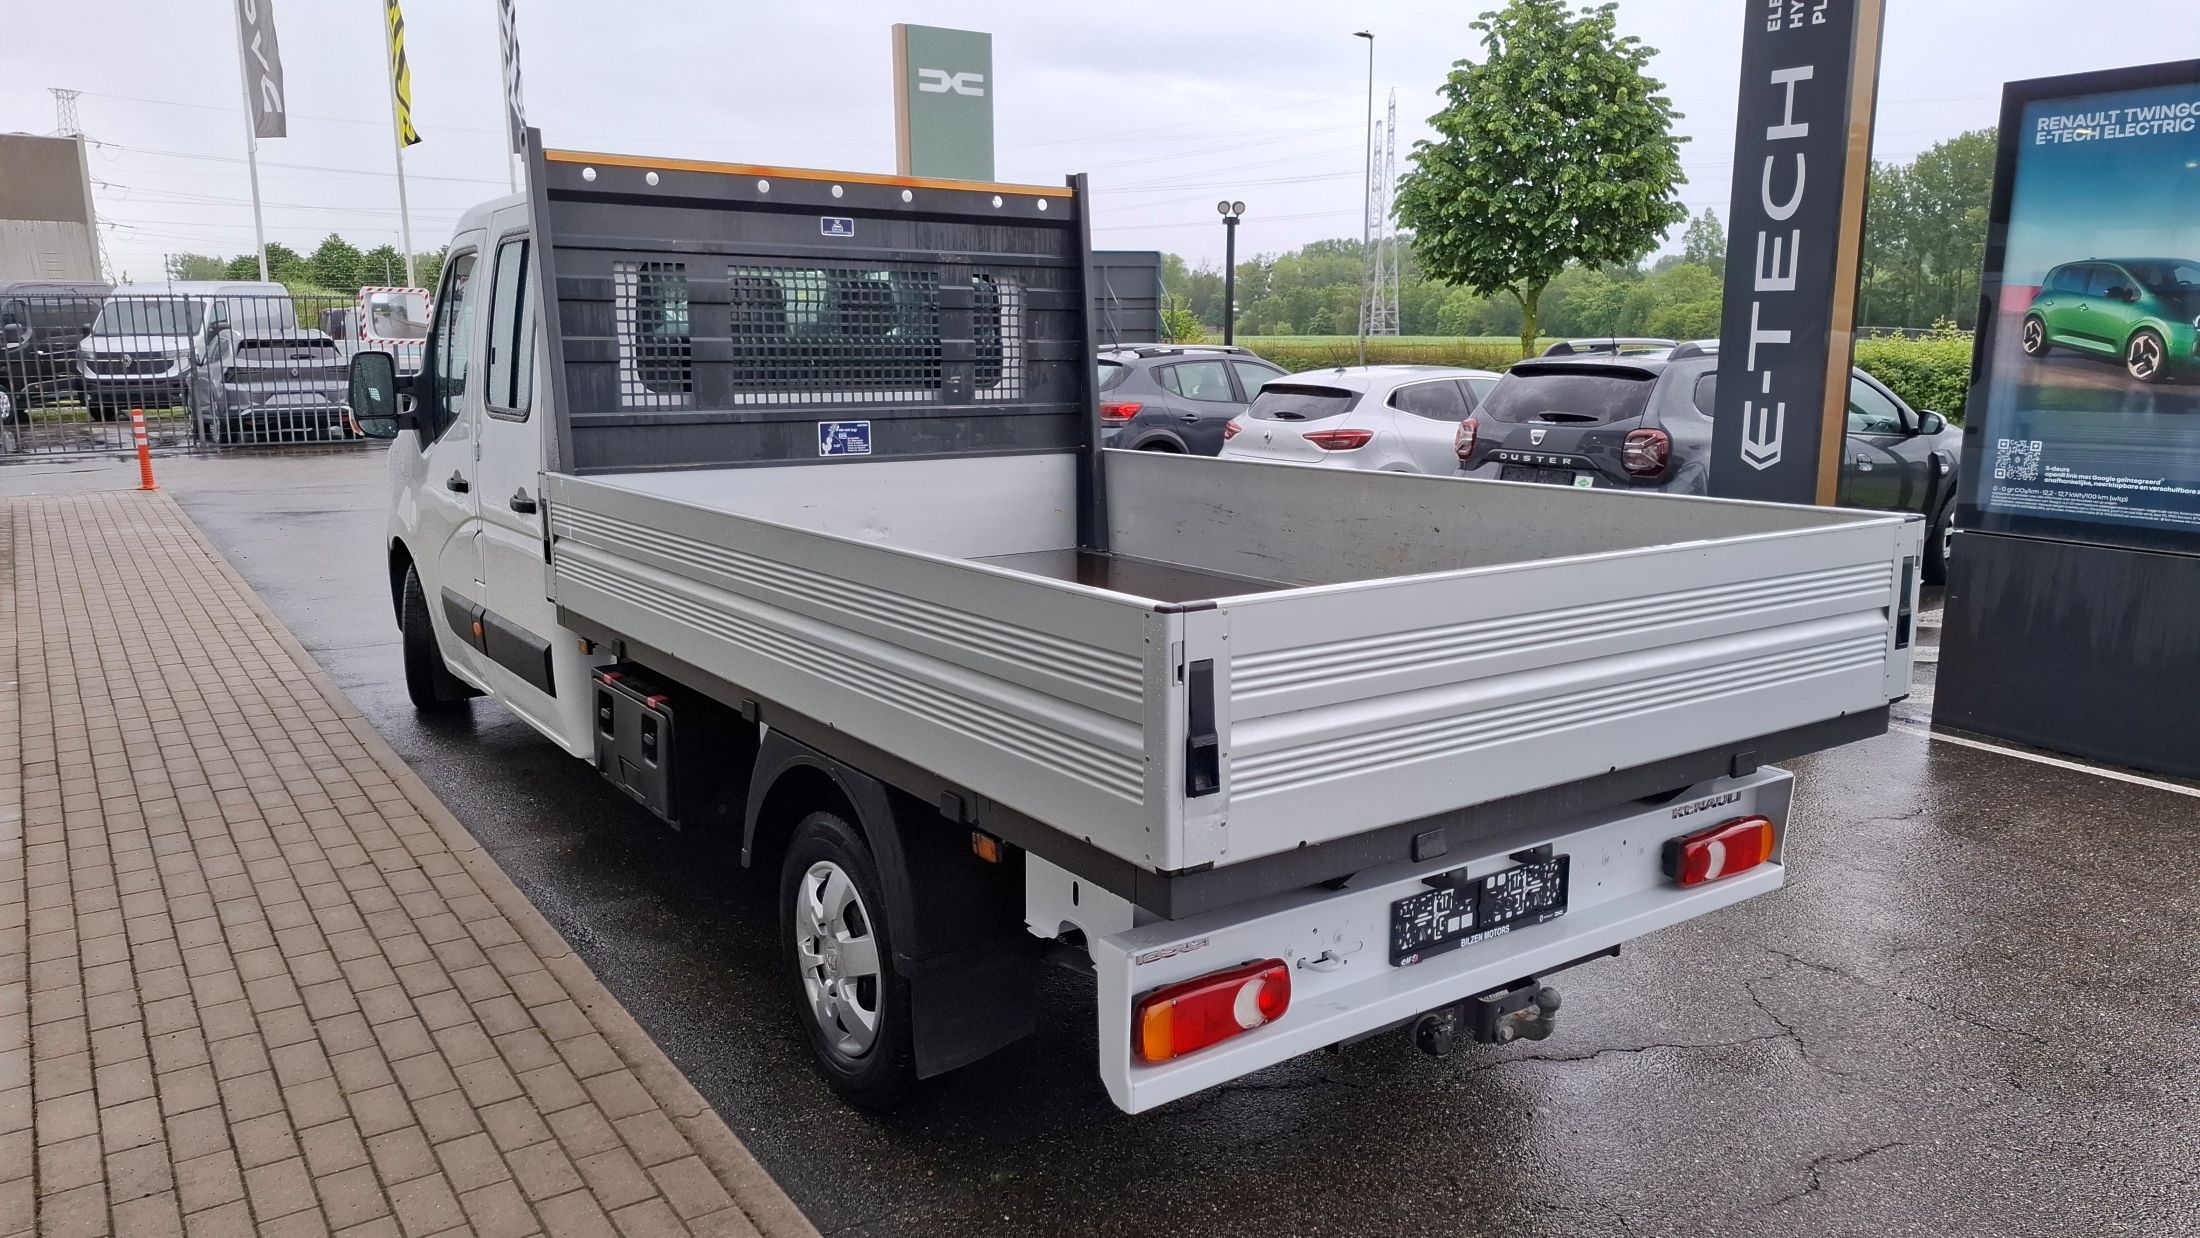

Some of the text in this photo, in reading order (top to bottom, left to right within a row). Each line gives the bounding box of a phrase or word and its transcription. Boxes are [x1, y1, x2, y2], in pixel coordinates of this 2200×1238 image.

[1789, 0, 1805, 28] HY
[1812, 0, 1828, 25] PL
[2037, 101, 2200, 131] RENAULT TWINGO
[2035, 117, 2196, 145] E-TECH ELECTRIC
[1741, 65, 1814, 471] E-TECH
[1500, 452, 1572, 465] DUSTER
[1460, 924, 1510, 948] BILZEN MOTORS
